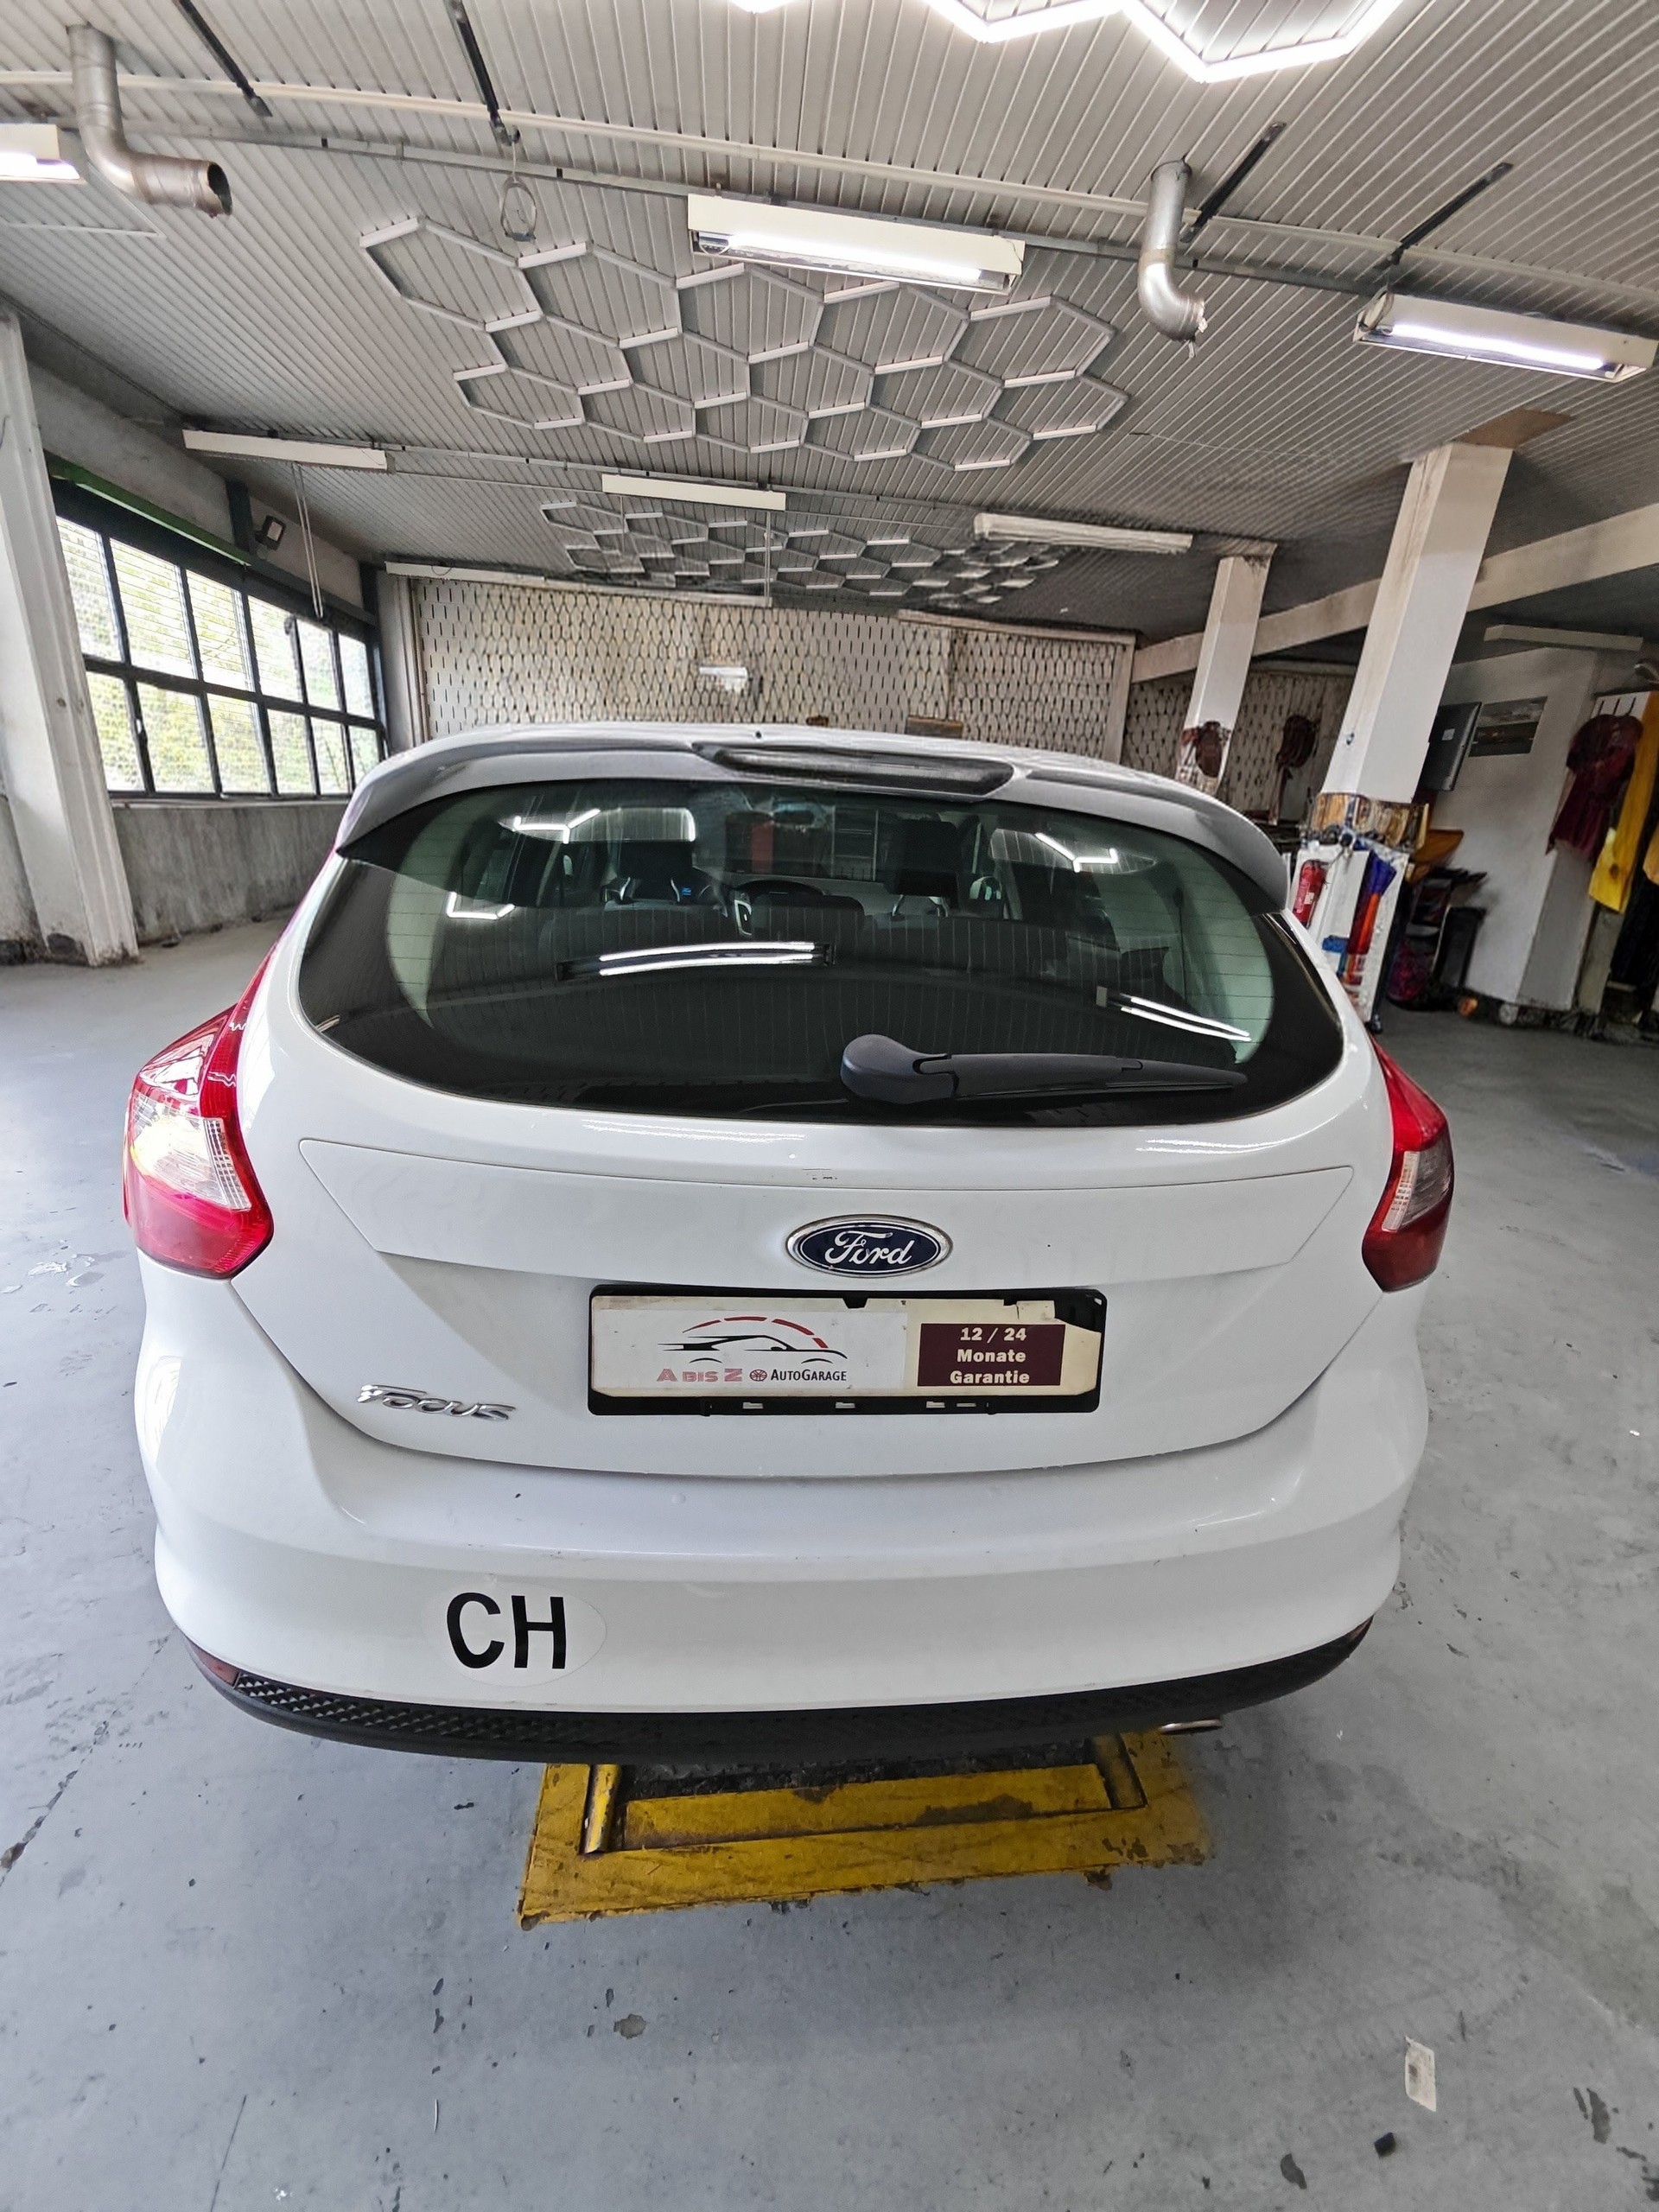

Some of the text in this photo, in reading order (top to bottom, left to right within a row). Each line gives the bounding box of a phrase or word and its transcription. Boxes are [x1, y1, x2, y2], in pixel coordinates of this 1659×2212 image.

[824, 1230, 915, 1265] Ford
[960, 1327, 983, 1341] 12
[1003, 1327, 1027, 1341] 24
[957, 1348, 1027, 1363] Monate
[656, 1368, 678, 1382] A
[723, 1368, 743, 1382] Z
[950, 1370, 1030, 1384] Garantie
[446, 1592, 567, 1670] CH
